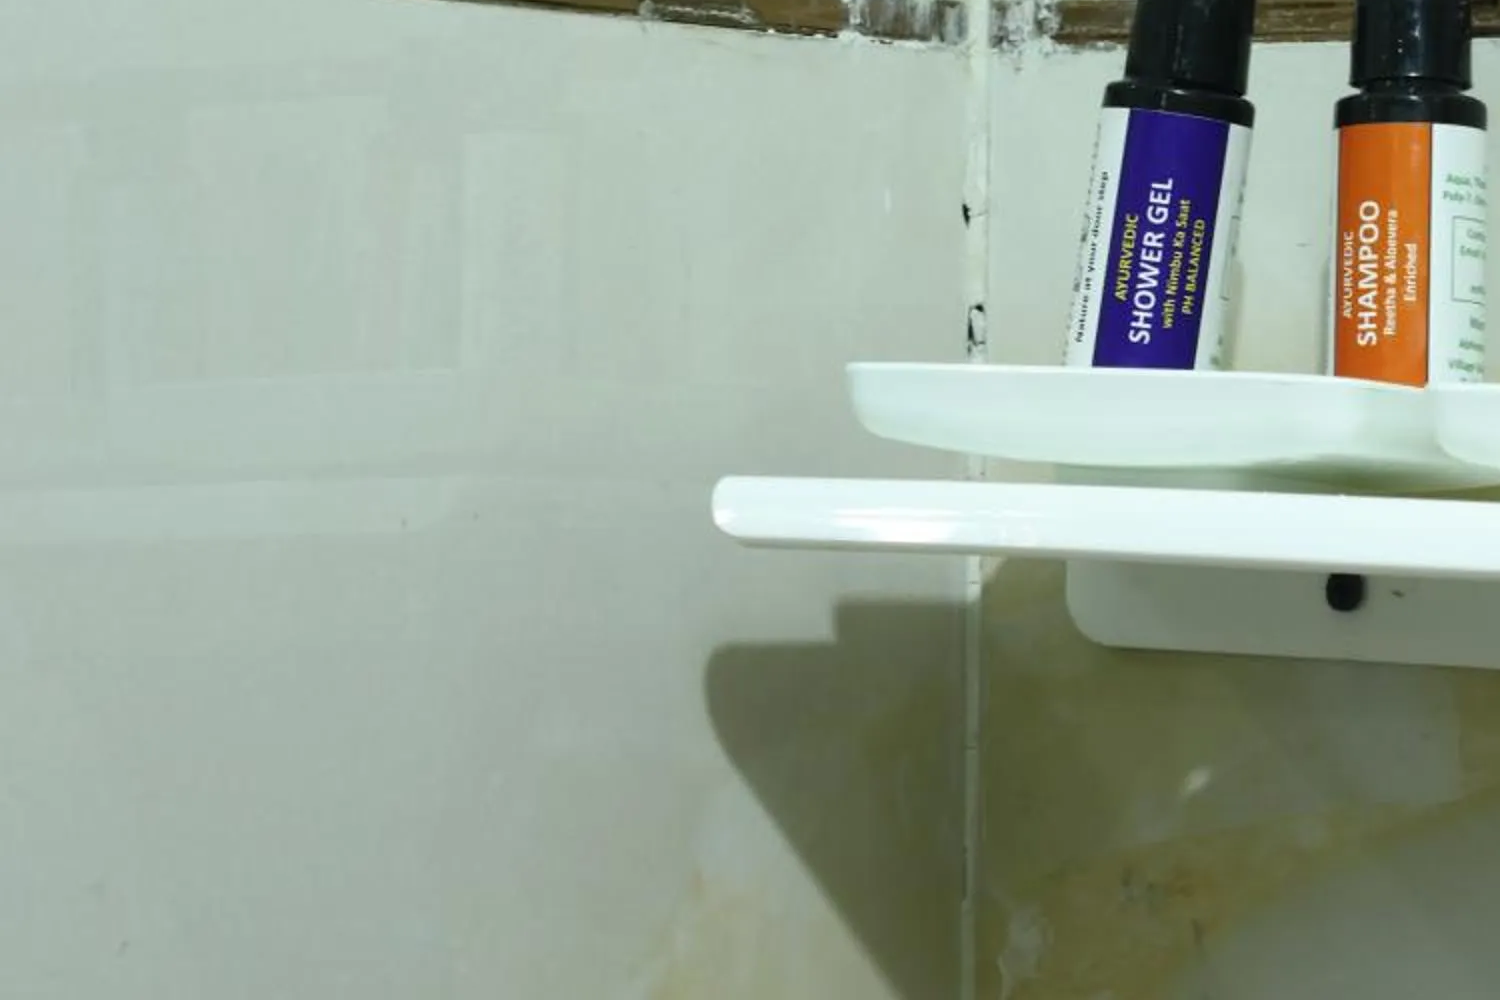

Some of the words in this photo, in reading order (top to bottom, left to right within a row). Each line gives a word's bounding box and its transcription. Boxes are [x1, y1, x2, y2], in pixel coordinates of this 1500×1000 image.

[1147, 177, 1174, 226] GEL
[1114, 214, 1139, 302] AYURVEDIC
[1173, 229, 1186, 249] Ka
[1186, 218, 1207, 293] BALANCED
[1384, 210, 1400, 269] Aloevera
[1129, 230, 1166, 345] SHOWER
[1168, 250, 1185, 297] Nimbu
[1343, 231, 1355, 319] AYURVEDIC
[1357, 200, 1380, 347] SHAMPOO
[1384, 270, 1398, 285] &
[1403, 243, 1419, 303] Enriched
[1163, 296, 1178, 329] with
[1181, 295, 1194, 316] PH
[1384, 288, 1398, 336] Reetha
